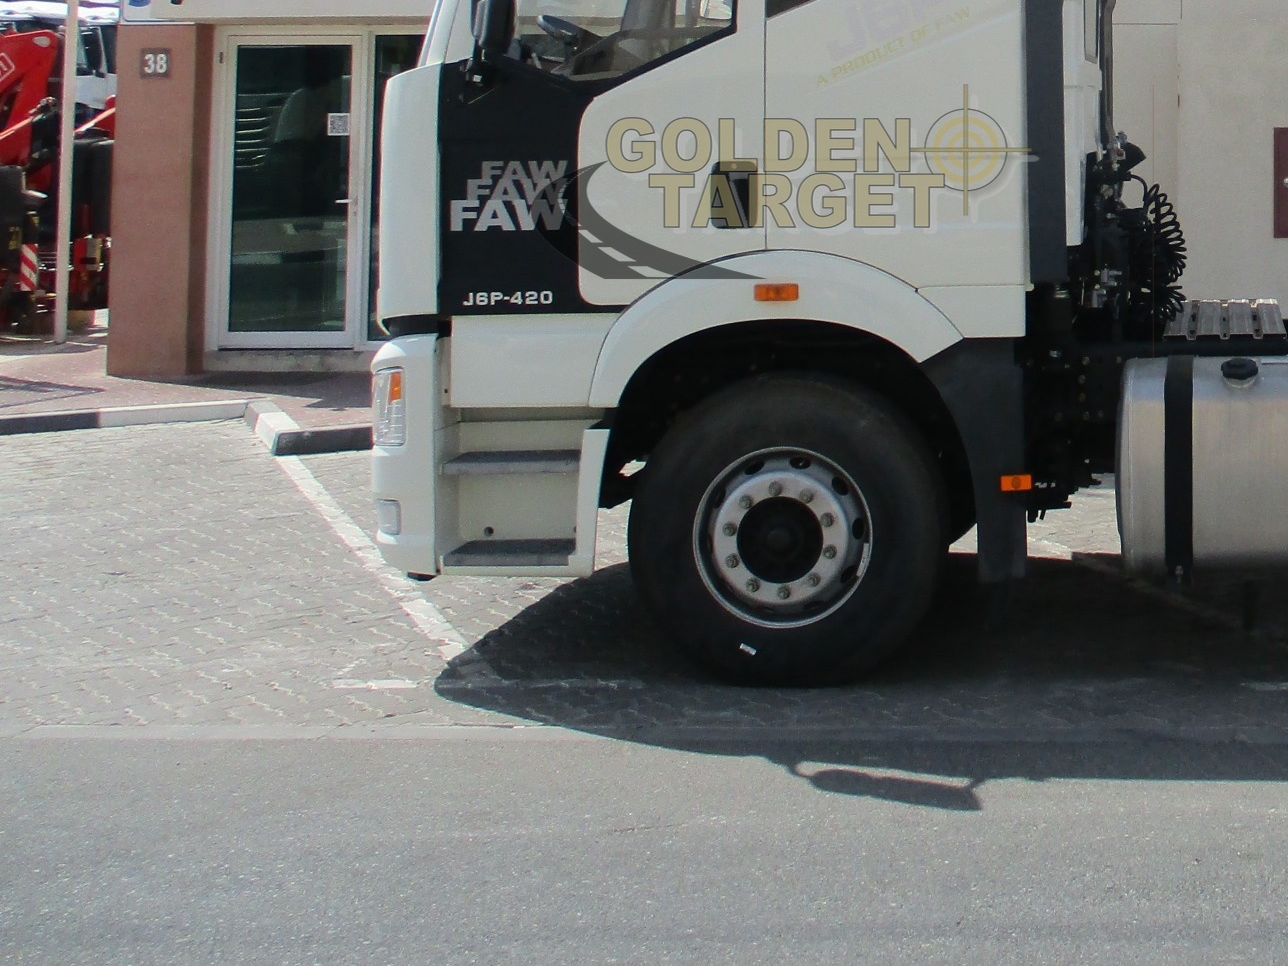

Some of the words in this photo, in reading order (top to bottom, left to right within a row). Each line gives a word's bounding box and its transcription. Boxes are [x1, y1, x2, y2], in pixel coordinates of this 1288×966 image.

[143, 53, 168, 74] 38
[450, 198, 568, 232] FAW
[462, 290, 554, 306] J6P-420
